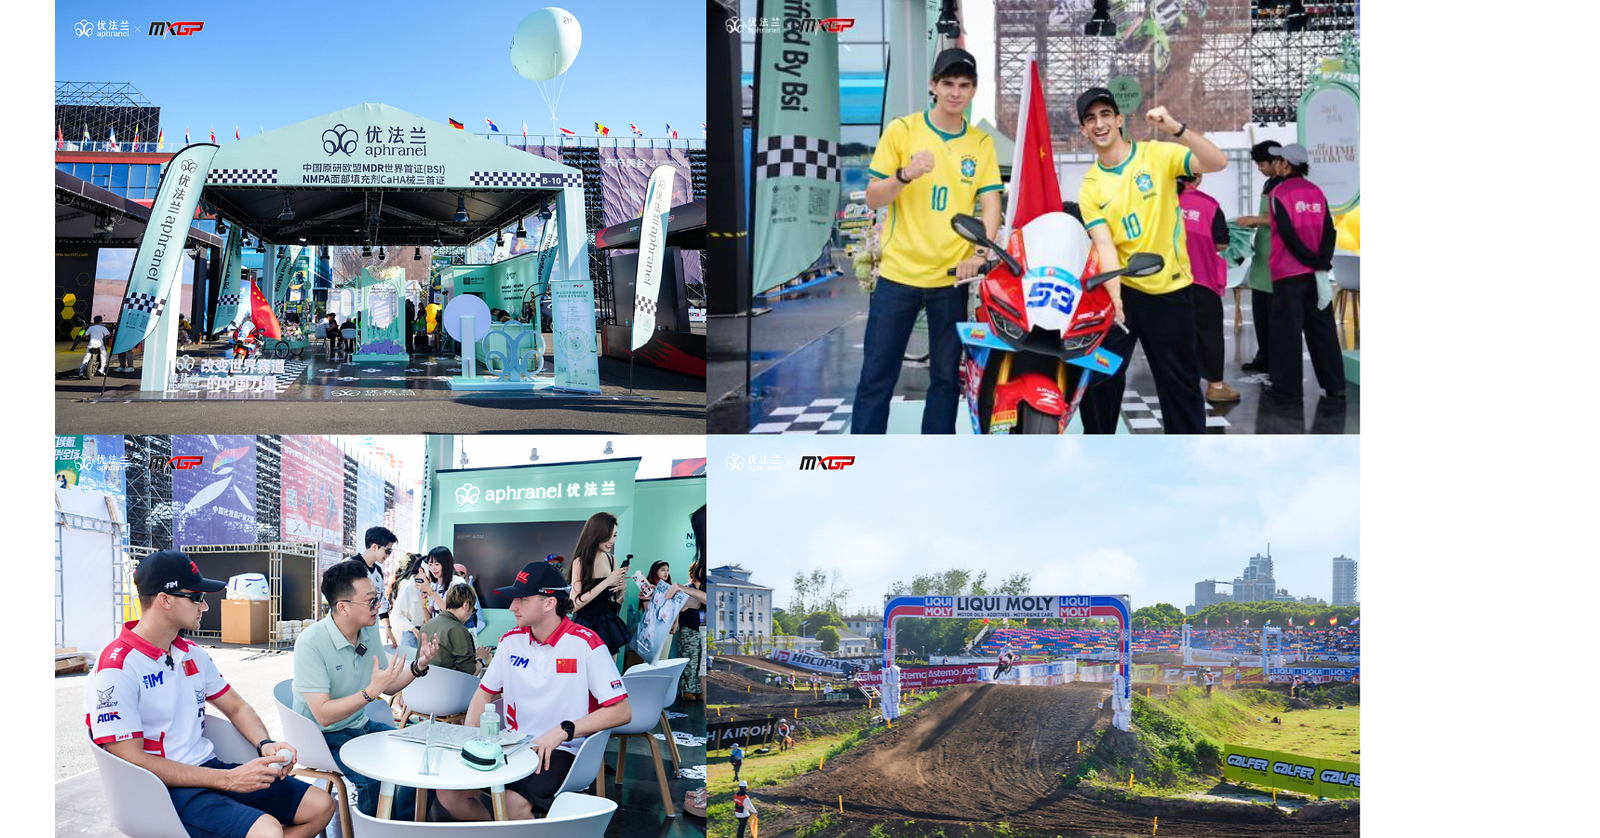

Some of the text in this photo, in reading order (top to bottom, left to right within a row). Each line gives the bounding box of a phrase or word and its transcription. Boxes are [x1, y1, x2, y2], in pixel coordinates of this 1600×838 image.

[774, 50, 809, 77] By
[781, 82, 809, 112] Bsi
[365, 125, 427, 144] 优法兰
[365, 144, 427, 158] aphranel
[302, 163, 446, 174] 中国原研欧盟MDR世界首证(BSI)
[302, 174, 446, 185] NMPA面部填充剂CaHA械三首证
[542, 177, 562, 185] B-10
[167, 174, 191, 215] 优法兰
[931, 185, 948, 211] 10
[1121, 212, 1142, 239] 10
[147, 215, 176, 282] aphranel
[644, 226, 658, 286] aphranel
[1026, 282, 1075, 315] 53
[201, 358, 286, 374] 改变世界赛道
[206, 375, 277, 390] 的中国力量
[485, 480, 616, 504] aphranel 优法兰
[925, 597, 952, 606] LIQUI
[957, 597, 1053, 611] LIQUI MOLY
[1060, 597, 1089, 606] LIQUI
[925, 607, 952, 616] MOLY
[1060, 607, 1090, 617] MOLY
[510, 655, 530, 669] FIM
[143, 670, 164, 689] FIM
[900, 672, 927, 680] stemo
[928, 669, 960, 678] Astemo
[722, 724, 772, 740] AIROH
[1227, 754, 1269, 771] GALFER
[1273, 761, 1315, 780] GALFER
